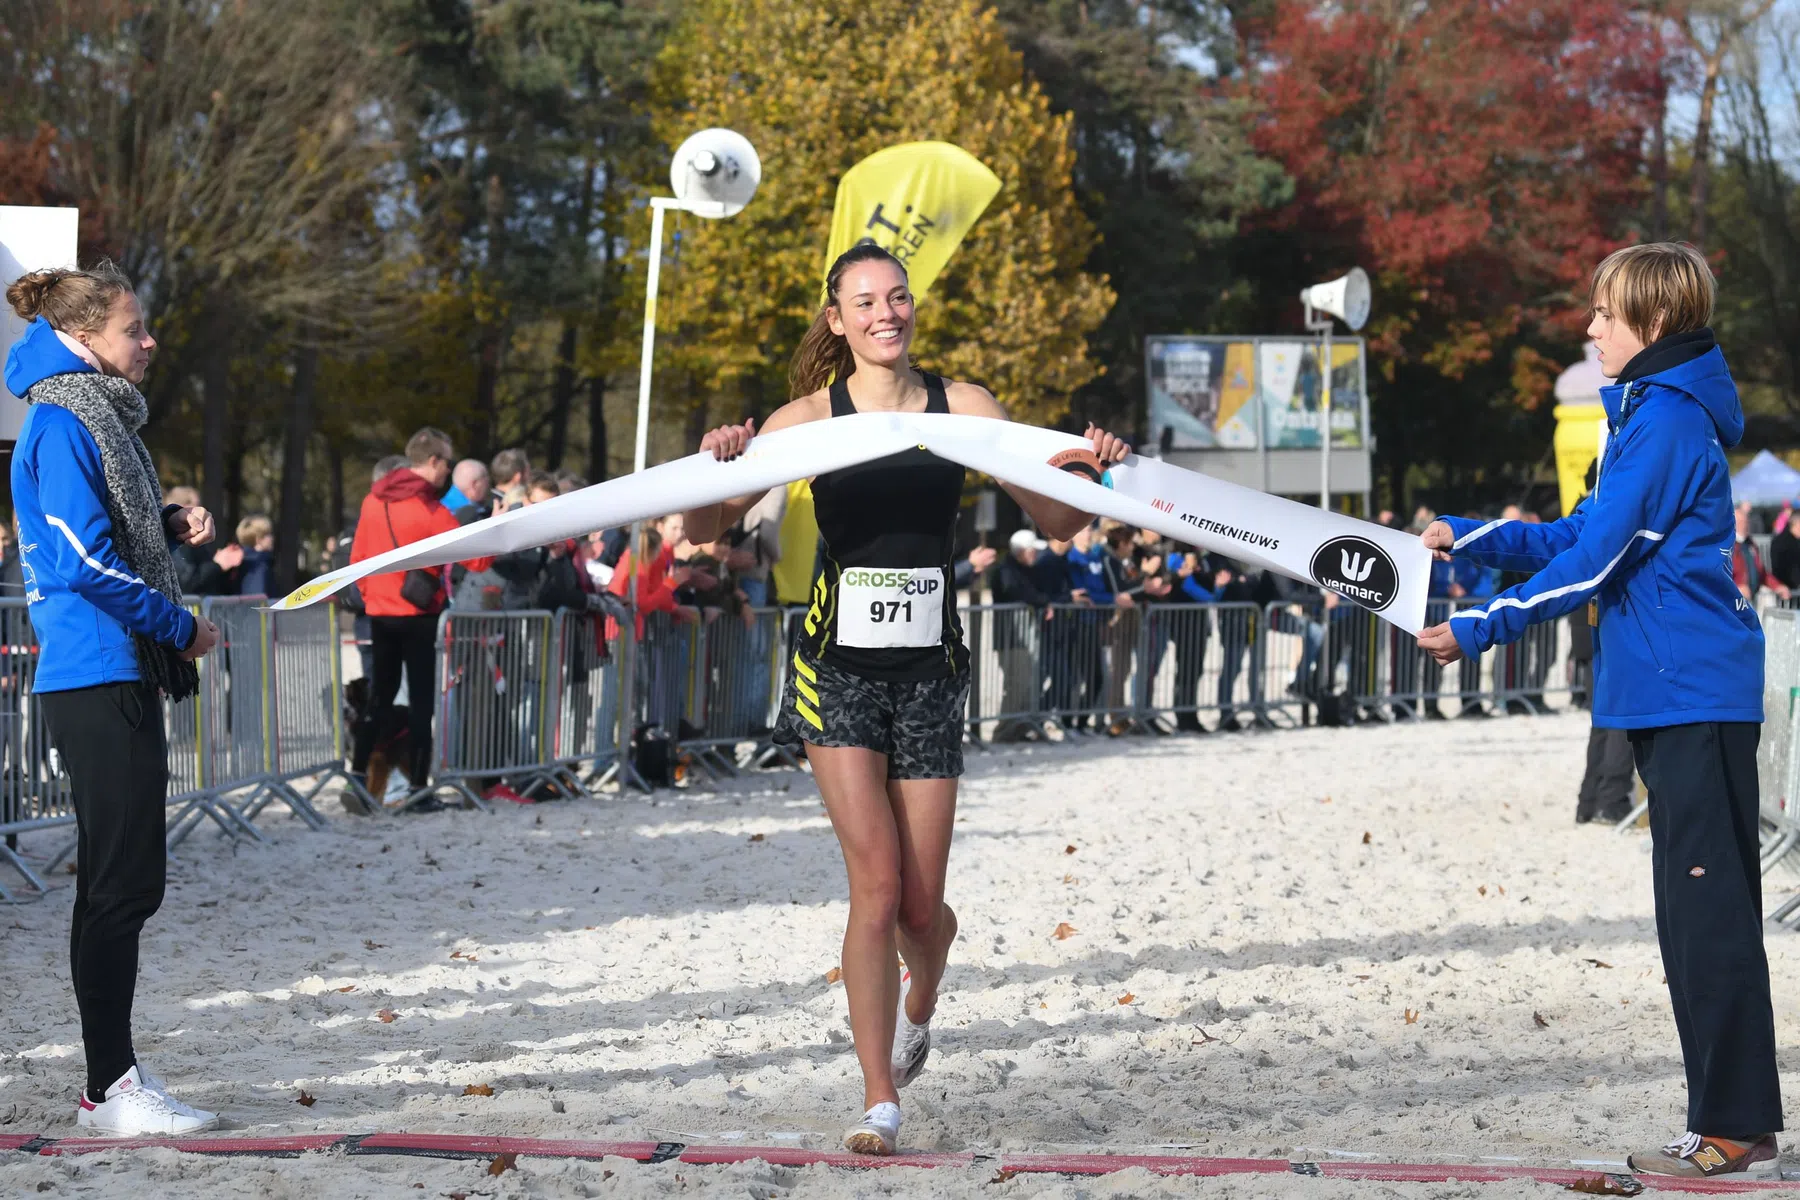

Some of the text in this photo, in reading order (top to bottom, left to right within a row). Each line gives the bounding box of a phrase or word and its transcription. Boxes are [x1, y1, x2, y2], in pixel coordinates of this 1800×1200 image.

[1062, 452, 1083, 461] LEVEL
[1180, 513, 1280, 550] ATLETIEKNIEUWS
[845, 571, 910, 587] CROSS
[903, 579, 939, 596] CUP
[1322, 577, 1382, 603] vermarc
[870, 601, 912, 623] 971
